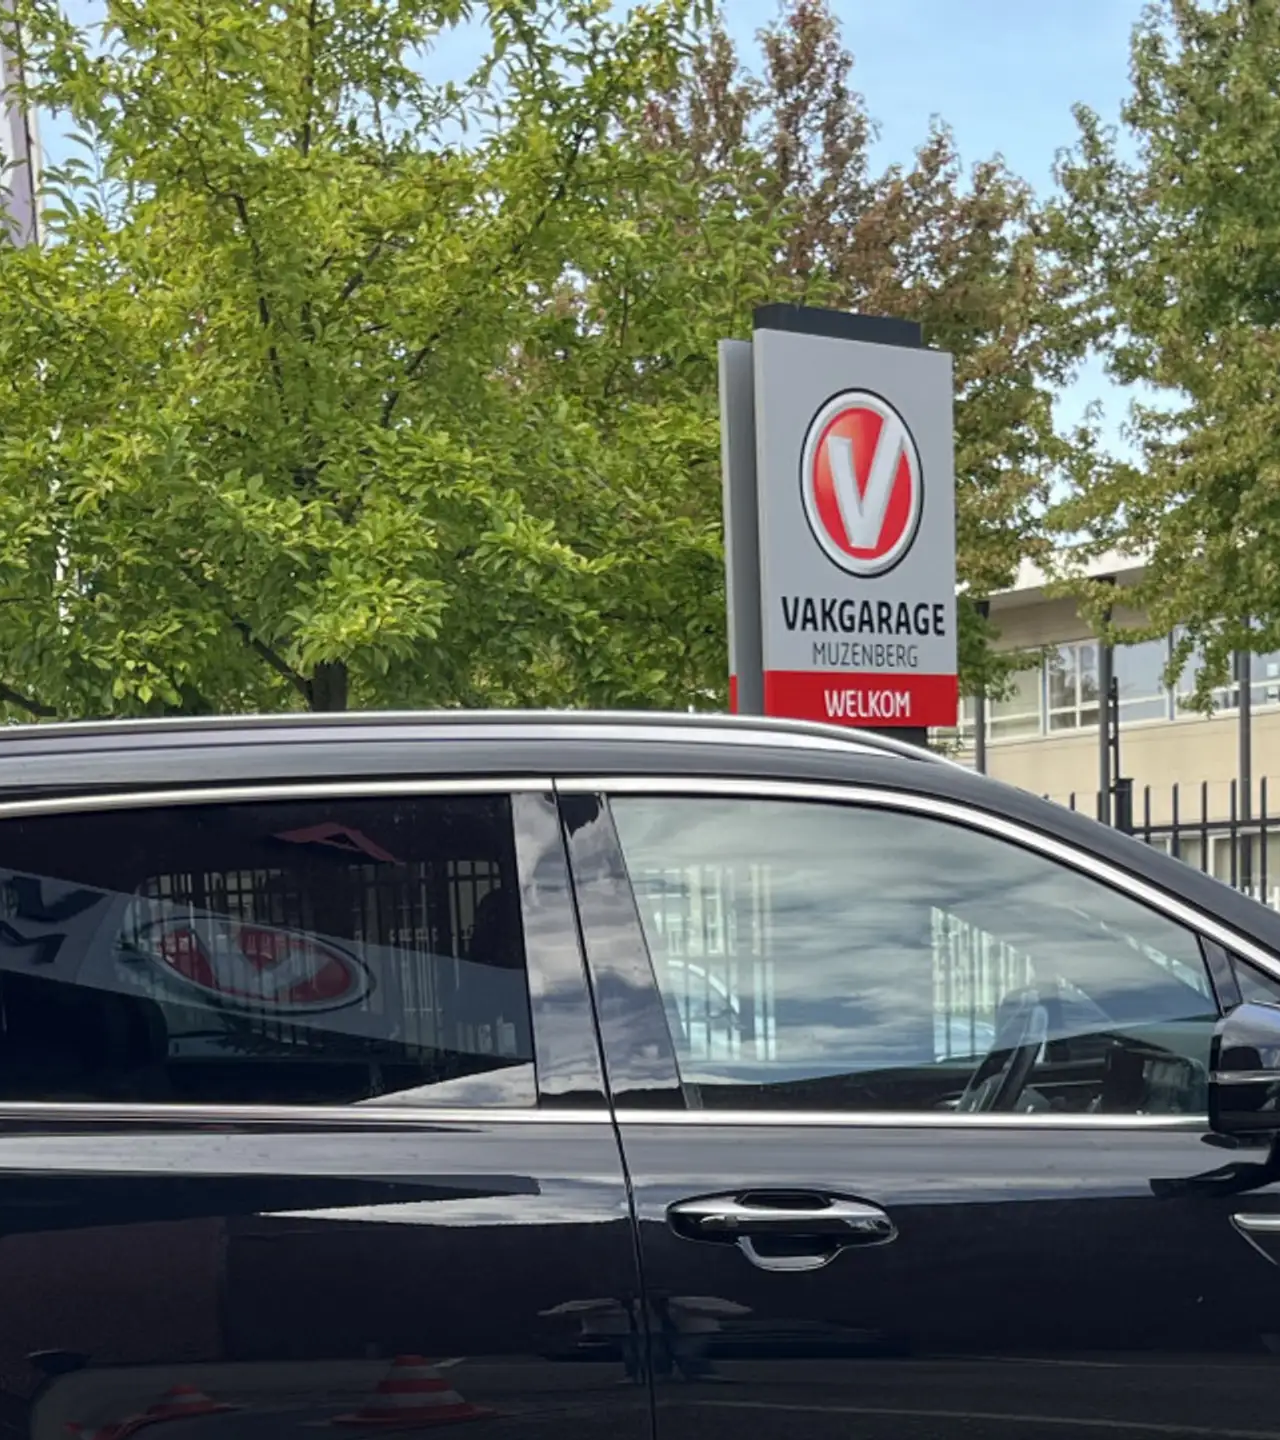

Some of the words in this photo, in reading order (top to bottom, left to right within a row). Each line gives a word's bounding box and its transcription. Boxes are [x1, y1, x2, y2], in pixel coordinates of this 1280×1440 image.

[780, 595, 947, 637] VAKGARAGE
[812, 641, 919, 668] MUZENBERG
[824, 689, 911, 718] WELKOM
